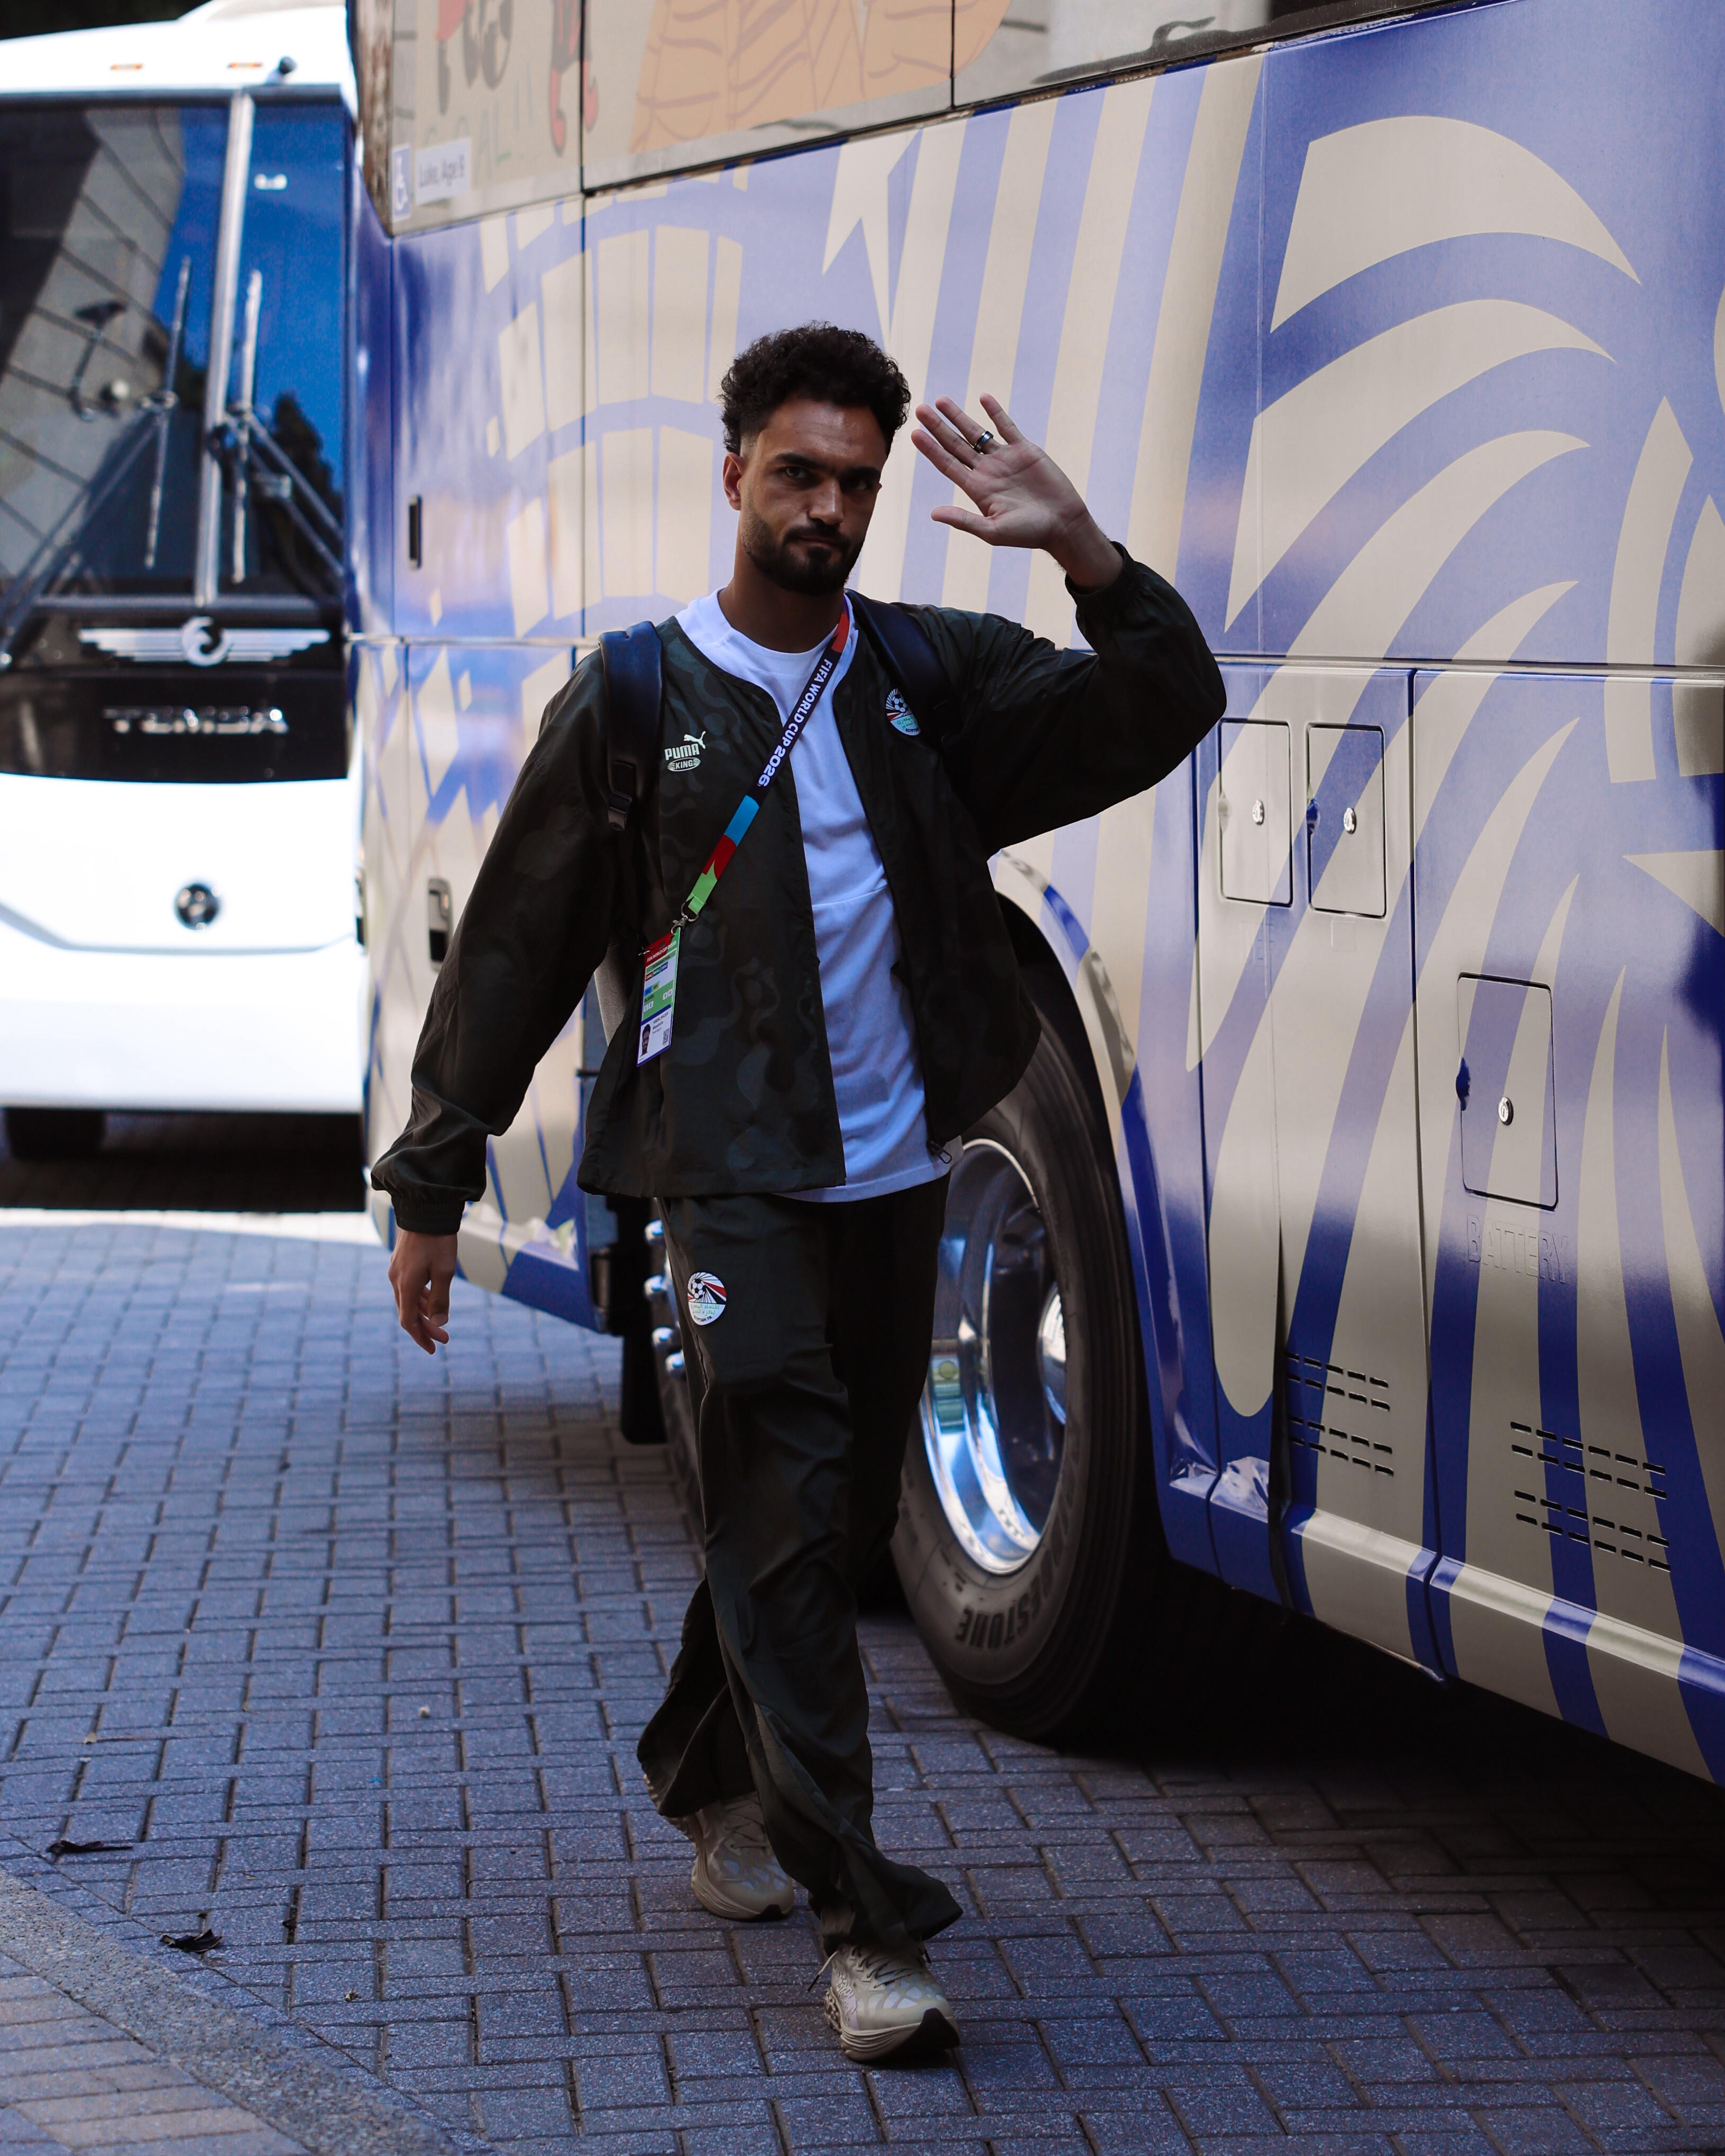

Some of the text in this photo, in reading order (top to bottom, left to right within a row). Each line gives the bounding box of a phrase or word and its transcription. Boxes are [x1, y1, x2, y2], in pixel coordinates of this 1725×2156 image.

[758, 659, 833, 787] FIFA WORLD CUP 2026
[664, 743, 700, 761] PUMA
[675, 760, 693, 770] KING
[1466, 1214, 1568, 1284] BATTERY
